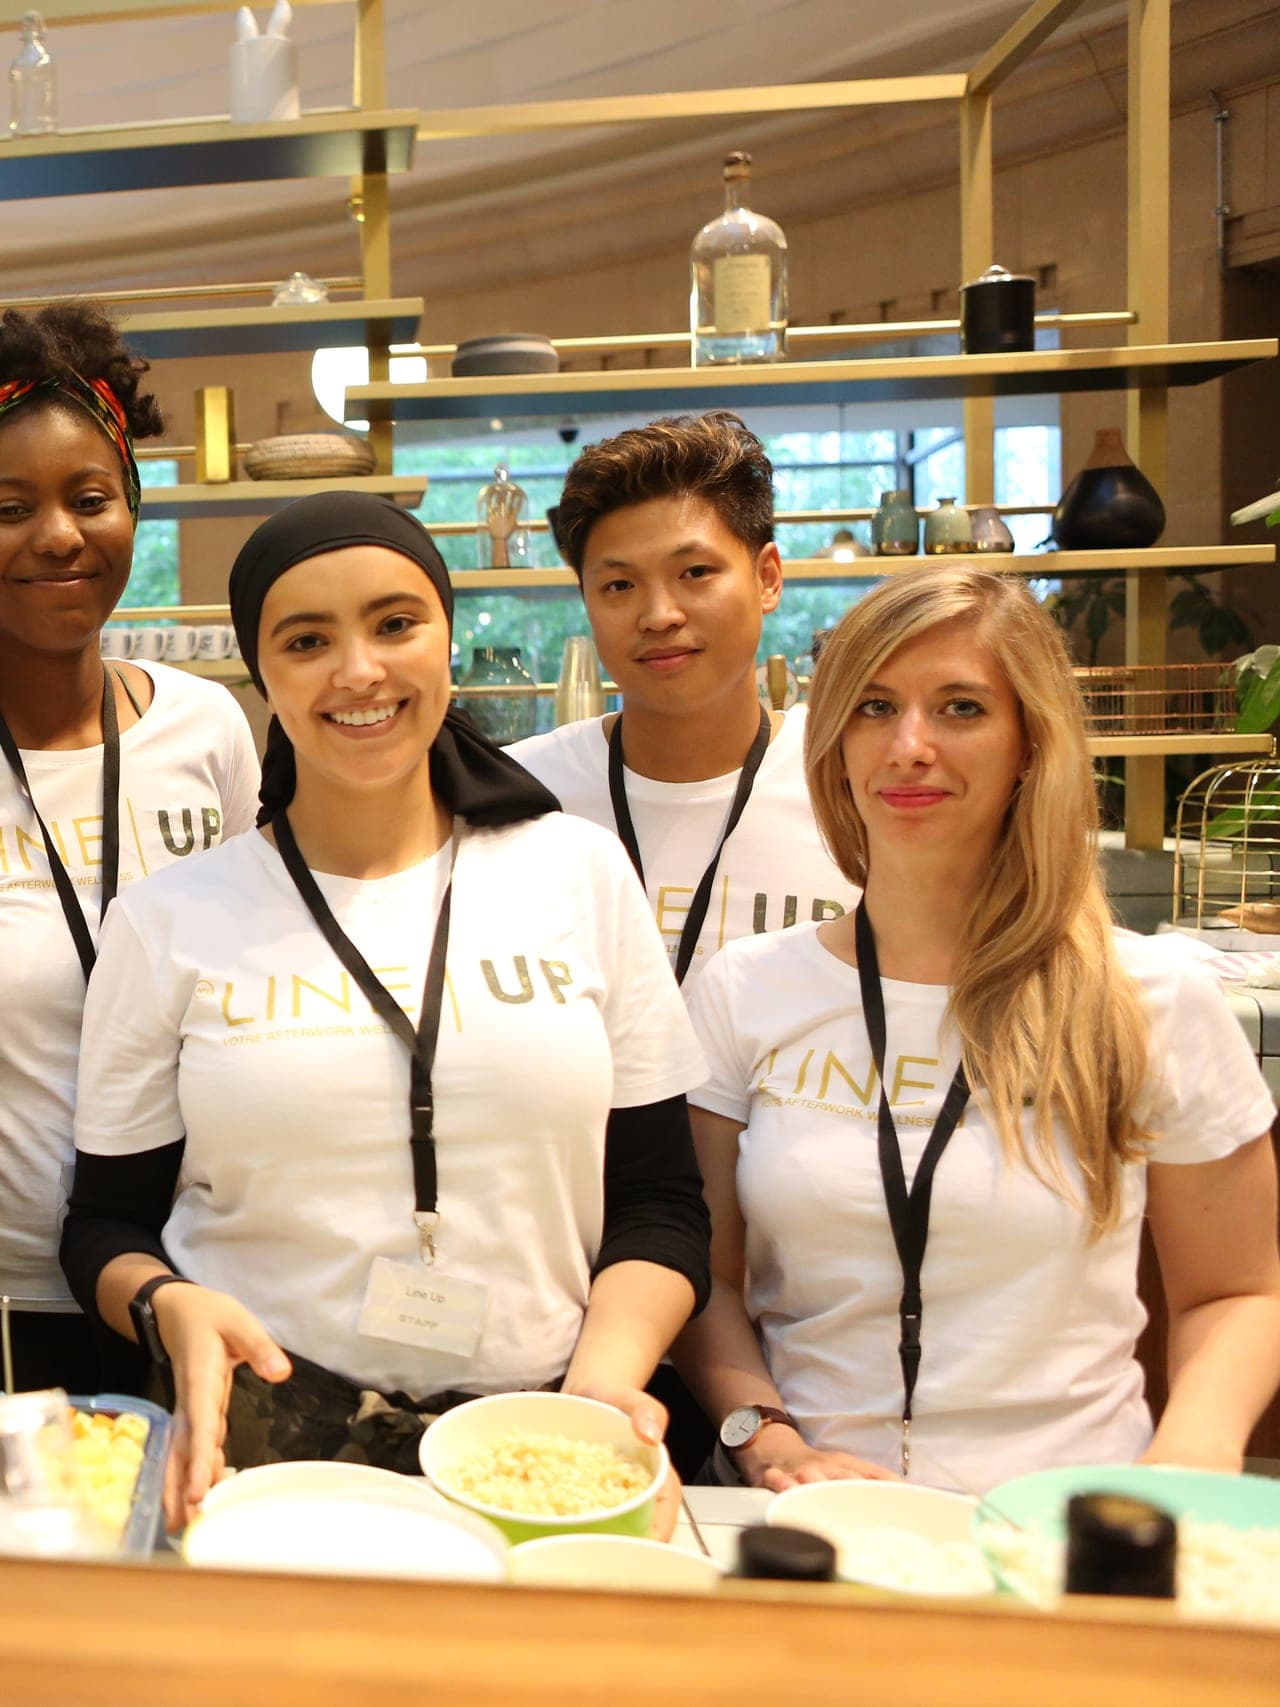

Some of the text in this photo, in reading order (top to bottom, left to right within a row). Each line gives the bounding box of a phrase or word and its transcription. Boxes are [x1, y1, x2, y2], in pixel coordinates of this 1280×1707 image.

[157, 807, 221, 857] UP
[7, 877, 74, 892] AFTERWO
[76, 872, 135, 887] WELSS
[222, 954, 574, 1027] LINE UP
[223, 1034, 262, 1049] VOTRE
[785, 1097, 864, 1119] AFTERWORK
[867, 1111, 935, 1128] WLNES
